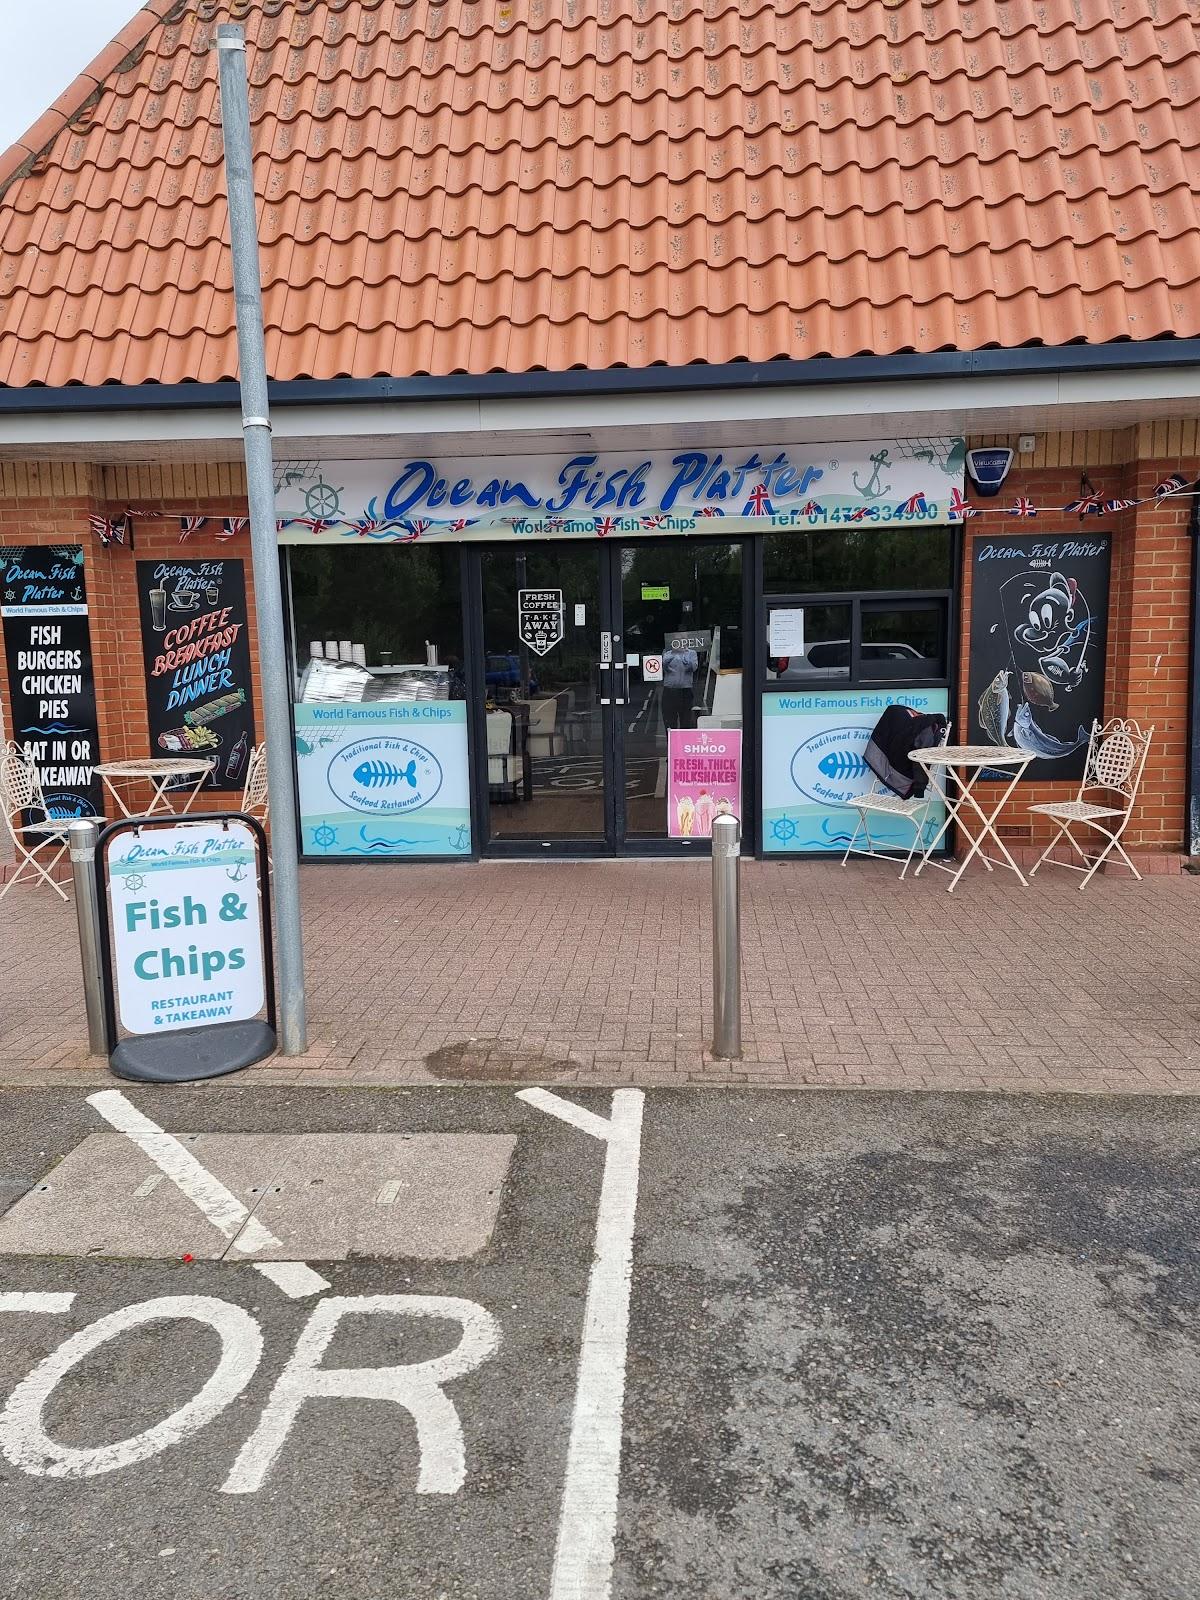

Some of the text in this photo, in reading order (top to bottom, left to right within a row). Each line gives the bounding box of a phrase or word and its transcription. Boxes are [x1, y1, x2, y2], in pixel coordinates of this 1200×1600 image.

[383, 452, 824, 520] Ocean Fish Platter
[556, 519, 604, 532] Famo
[978, 541, 1105, 561] Ocean Fish Platter
[6, 564, 76, 583] Ocean Fish
[154, 562, 224, 579] Ocean Fish
[22, 585, 64, 602] Platter
[175, 576, 216, 591] Platter
[523, 601, 558, 609] COFFEE
[525, 593, 556, 601] FRESH
[30, 625, 62, 646] FISH
[163, 606, 234, 650] COFFEE
[524, 621, 558, 630] AWAY
[151, 623, 243, 676] BREAKFAST
[671, 637, 705, 650] OPEN
[17, 650, 82, 671] BURGERS
[172, 648, 232, 688] LUNCH
[21, 675, 82, 695] CHICKEN
[165, 668, 236, 712] DINNER
[39, 699, 69, 719] PIES
[779, 695, 929, 709] World Famous Fish & Chips
[312, 707, 452, 720] World Famous Fish & Chips
[52, 741, 67, 761] IN
[71, 740, 91, 760] OR
[341, 742, 382, 762] Traditional
[384, 741, 401, 750] Fish
[410, 747, 429, 763] Chips
[684, 744, 726, 753] SHMOO
[806, 732, 850, 753] Traditional
[28, 766, 94, 787] KEAWAY
[673, 771, 737, 783] MILKSHAKES
[349, 791, 422, 809] Seafood Restaurant
[812, 782, 844, 800] Seafood
[127, 838, 244, 862] Ocean Fish Platter
[125, 892, 248, 933] Fish &
[133, 944, 246, 981] Chips
[151, 990, 234, 1011] RESTAURANT
[154, 1005, 233, 1025] & TAKEAWAY
[0, 1291, 502, 1494] OR
